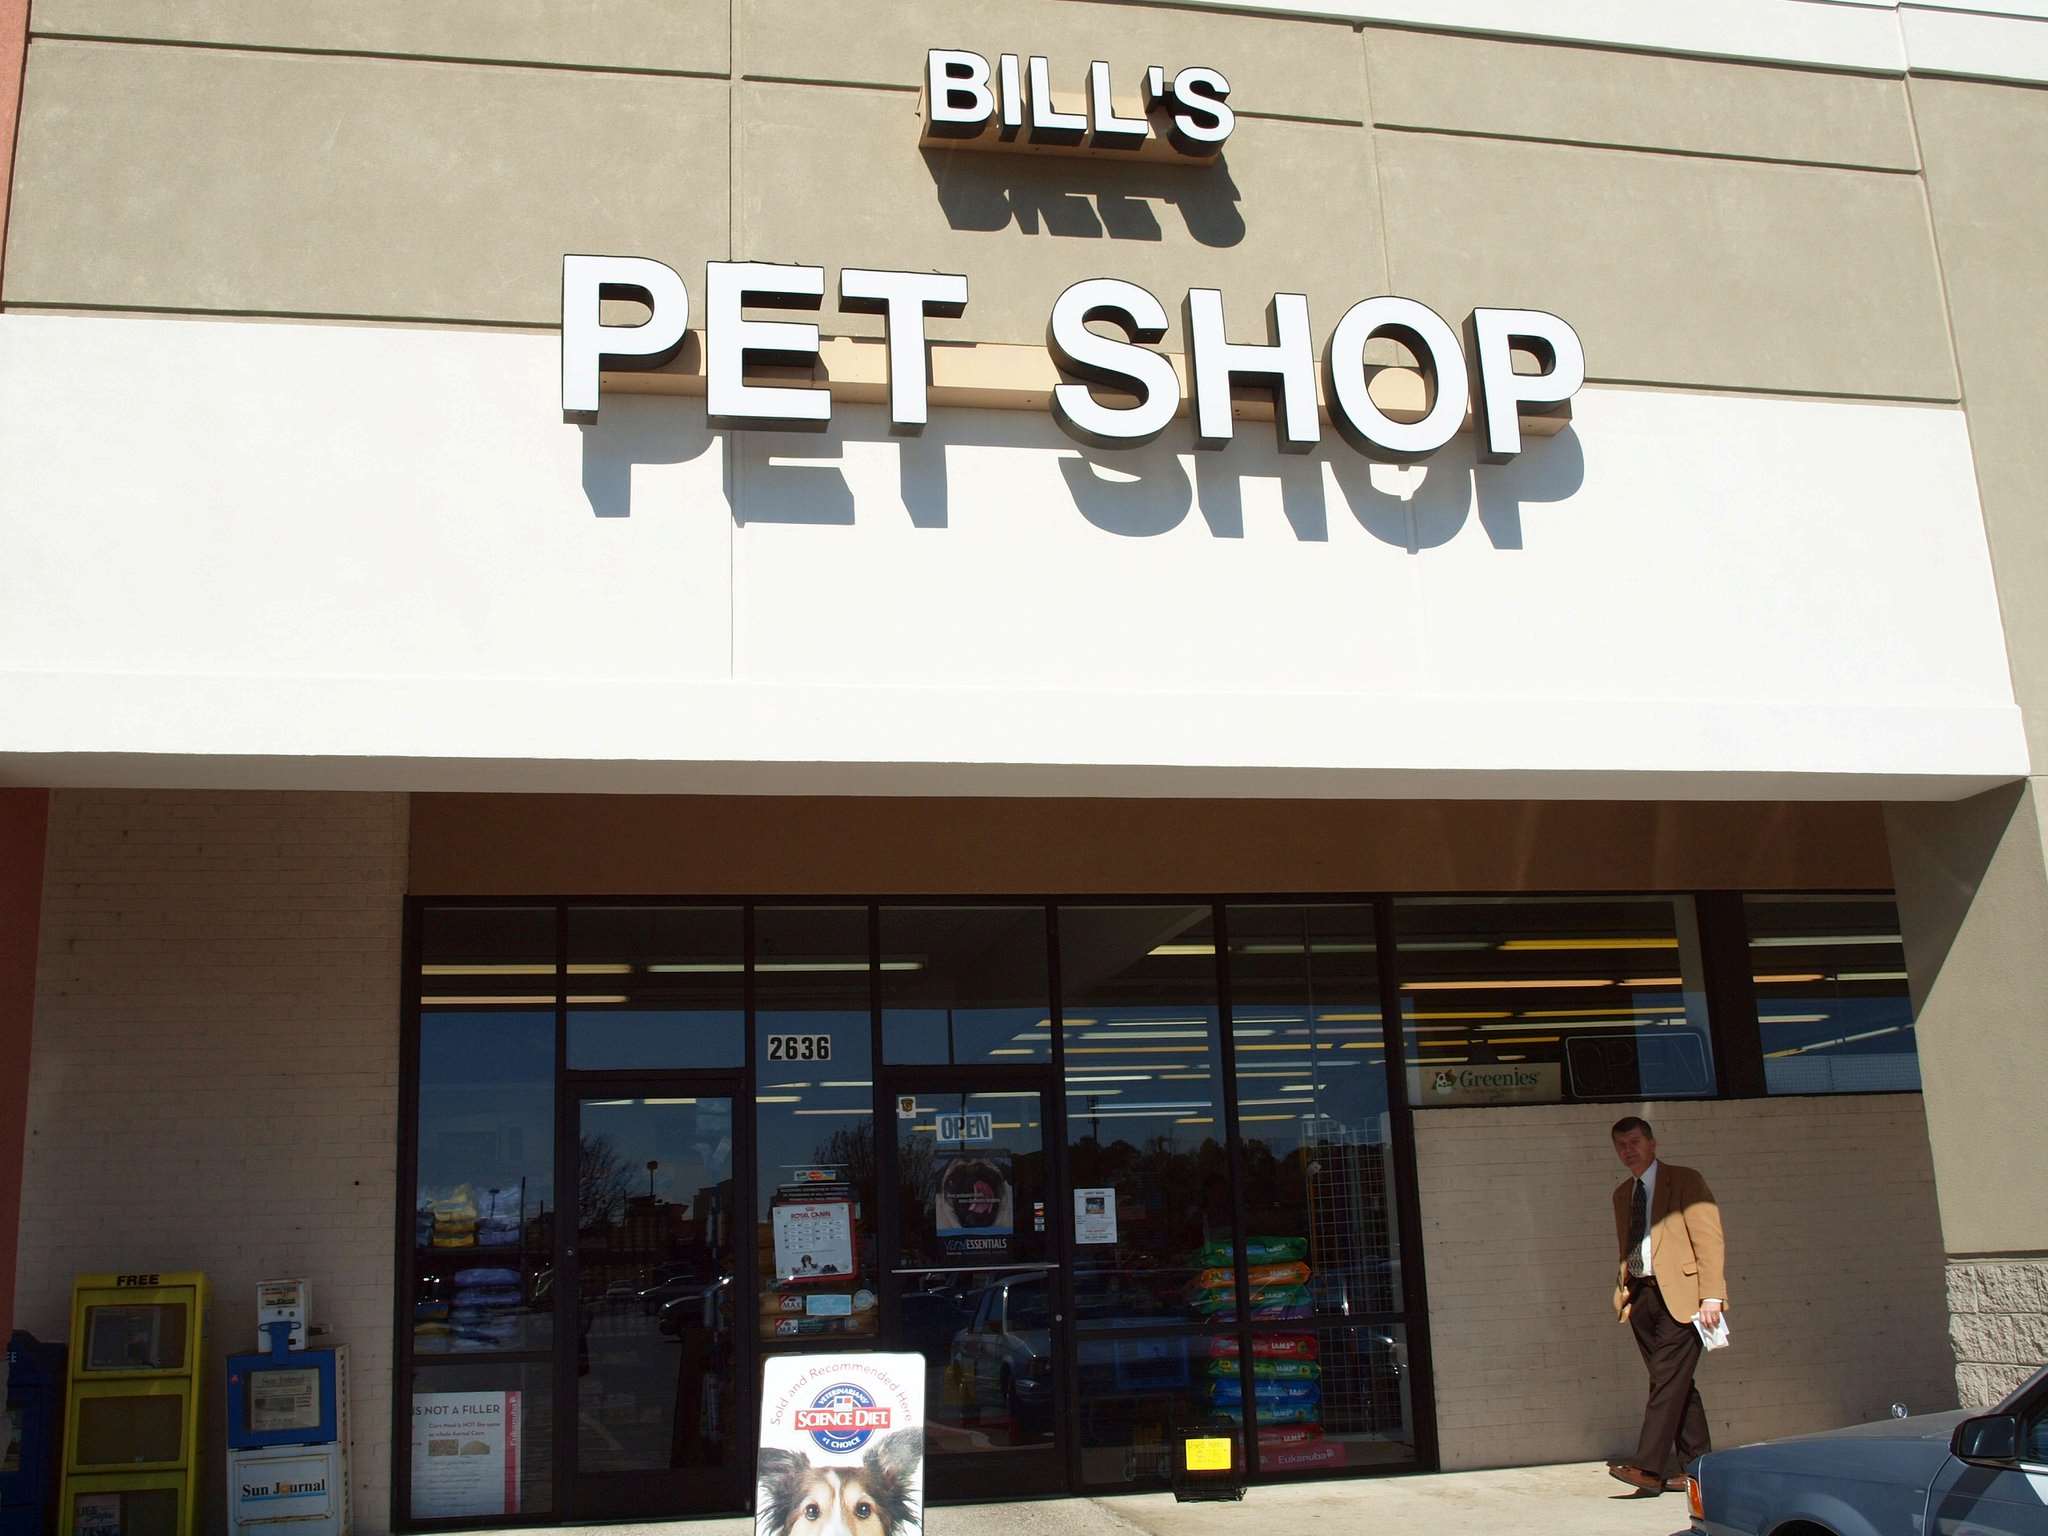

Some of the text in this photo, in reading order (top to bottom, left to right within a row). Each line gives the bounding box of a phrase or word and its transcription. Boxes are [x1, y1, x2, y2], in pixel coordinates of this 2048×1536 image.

[926, 48, 1235, 153] BILL'S
[562, 253, 1585, 463] PET SHOP
[769, 1037, 830, 1060] 2636
[1460, 1067, 1537, 1088] Greenies
[941, 1114, 990, 1139] OPEN
[117, 1274, 160, 1287] FREE
[770, 1363, 912, 1425] Sold and Recommended Here
[425, 1406, 448, 1415] NOT
[452, 1405, 459, 1415] A
[463, 1404, 500, 1415] FILLER
[831, 1436, 861, 1449] CHOICE
[242, 1484, 269, 1497] Sun
